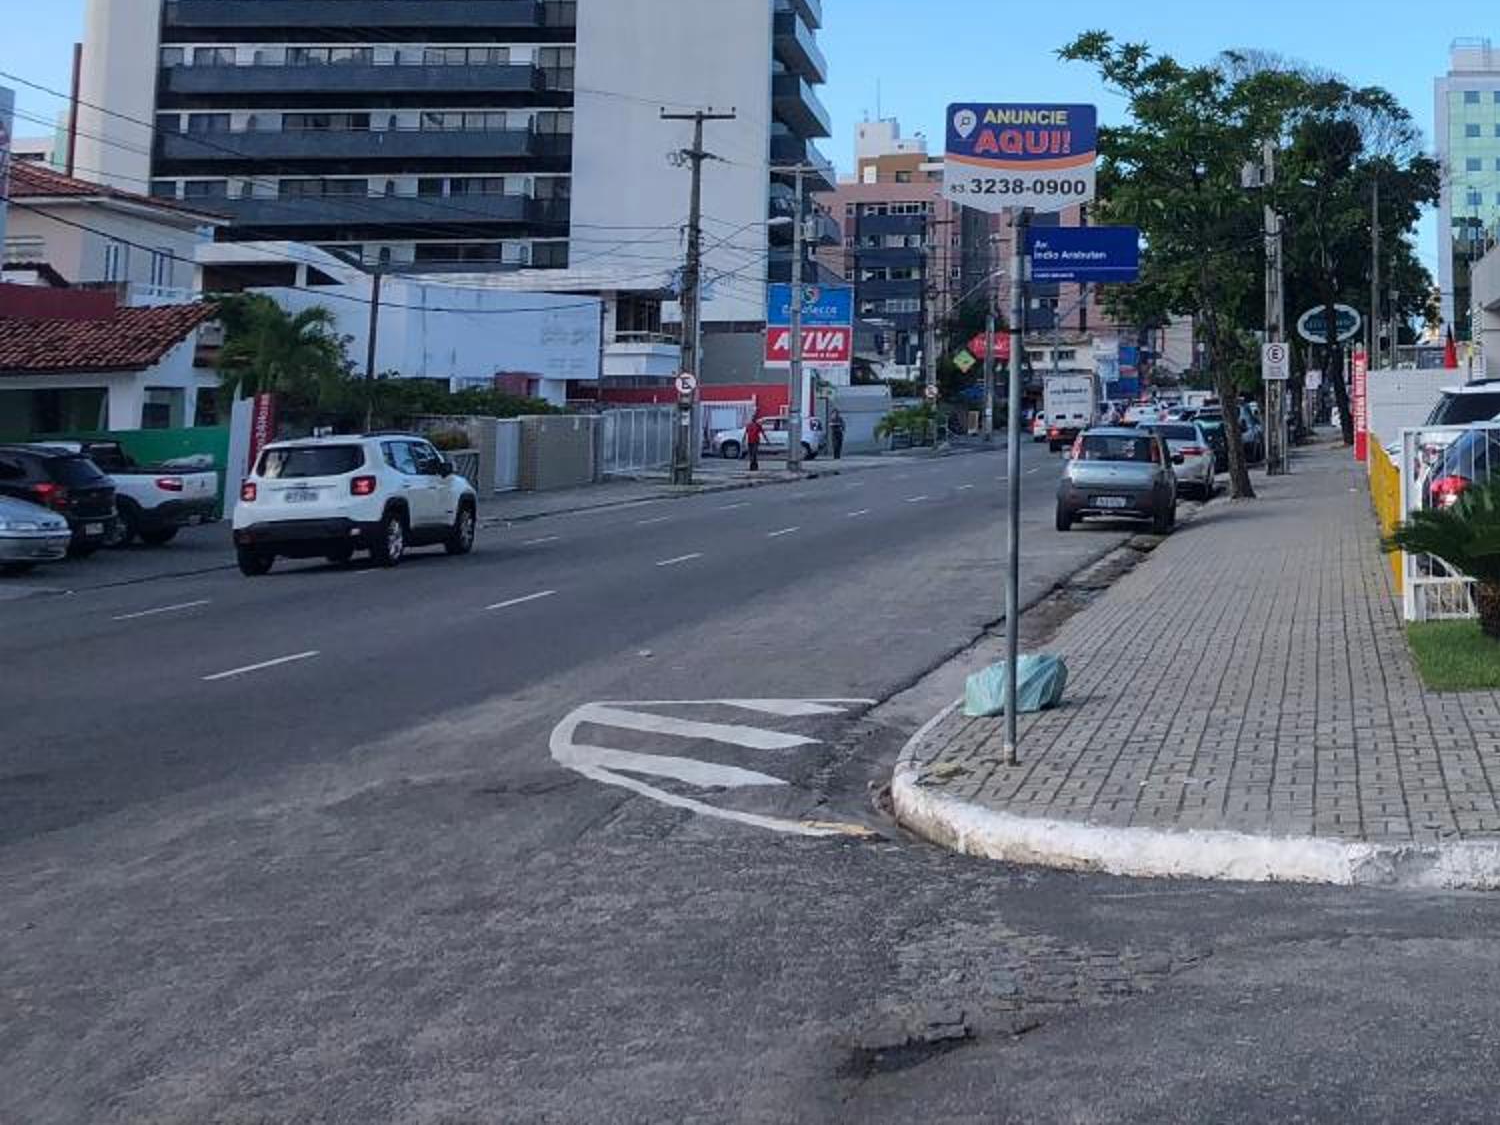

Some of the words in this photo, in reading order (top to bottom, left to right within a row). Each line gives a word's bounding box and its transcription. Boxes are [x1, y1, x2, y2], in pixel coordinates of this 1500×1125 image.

[983, 109, 1069, 124] ANUNCIE
[975, 128, 1071, 155] AQUI!
[970, 178, 1087, 195] 3238-0900
